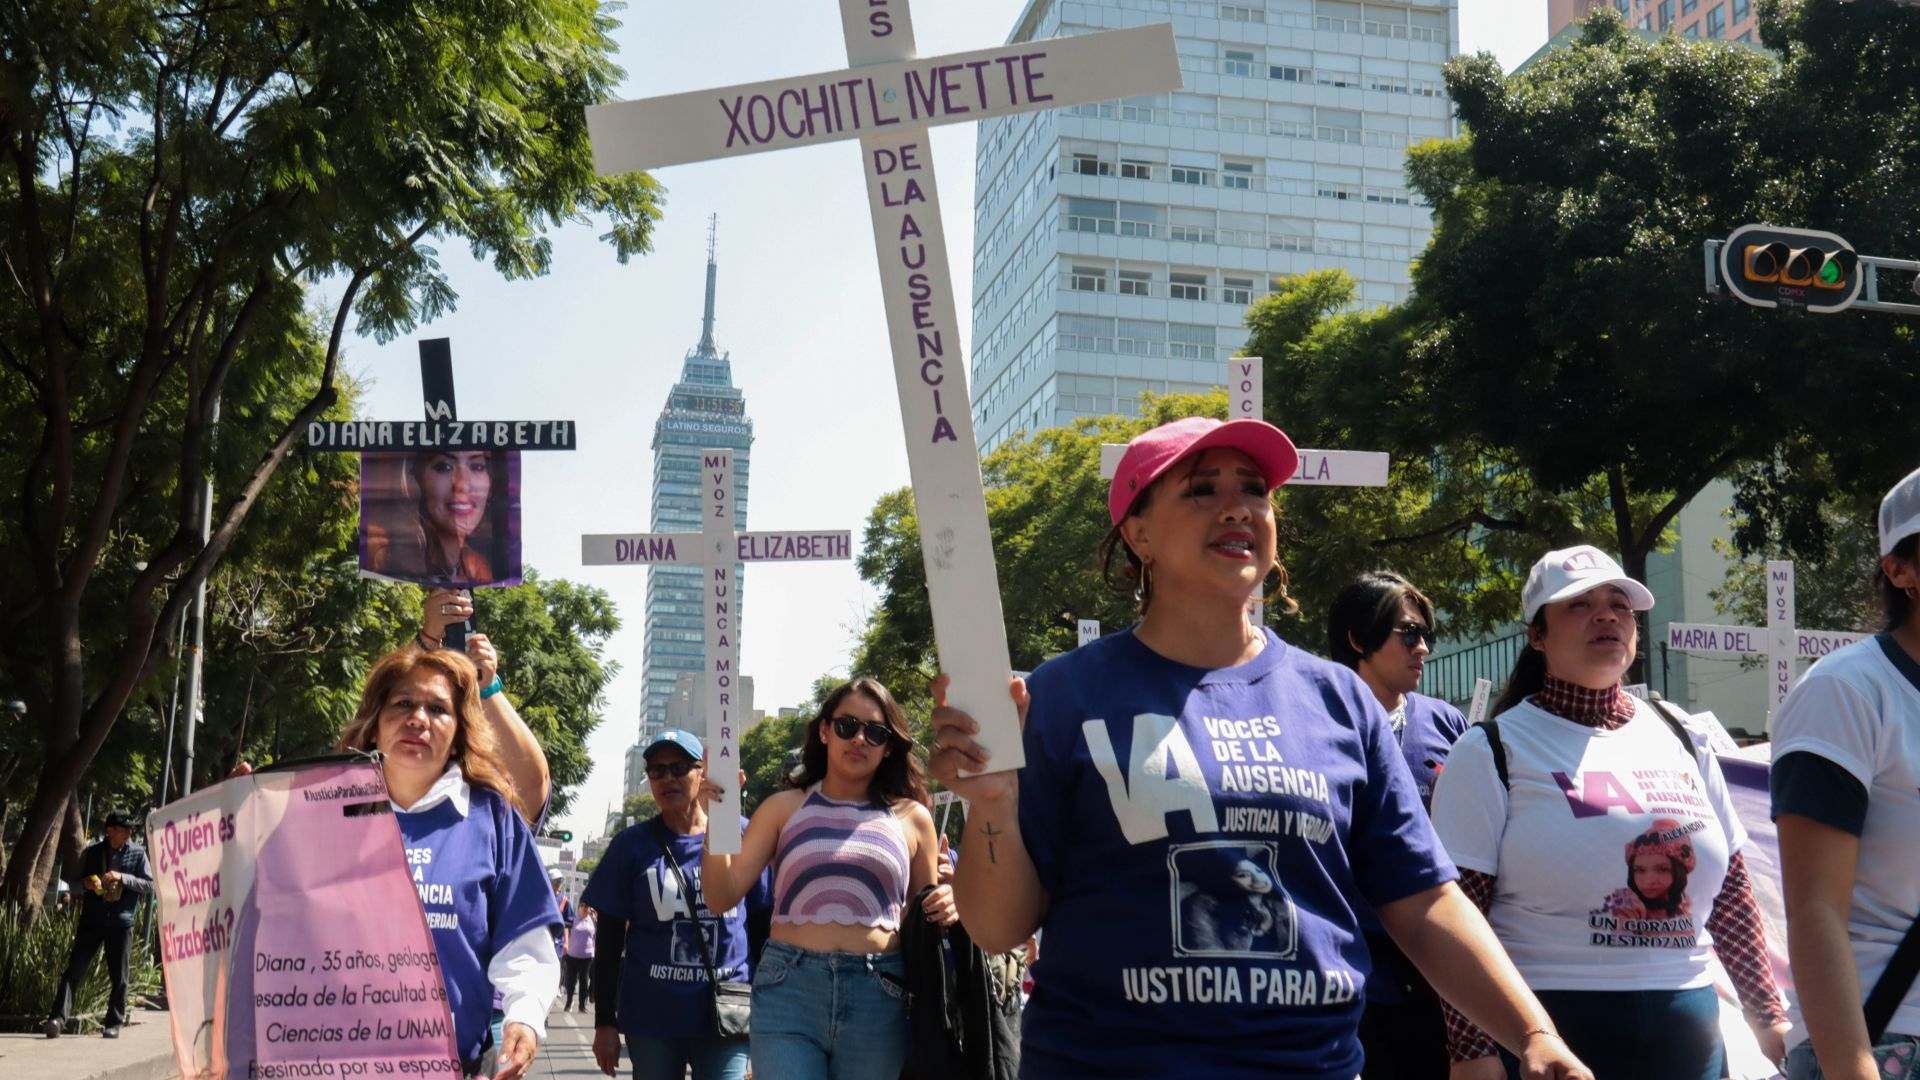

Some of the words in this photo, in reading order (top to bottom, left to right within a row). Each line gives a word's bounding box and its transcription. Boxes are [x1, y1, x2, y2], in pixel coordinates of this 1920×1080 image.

[718, 77, 900, 150] XOCHITL
[904, 52, 1054, 121] IVETTE
[873, 144, 921, 175] DE
[880, 178, 926, 207] LA
[899, 214, 958, 443] AUSENCIA
[1241, 363, 1252, 419] VOC
[425, 400, 453, 421] VA
[308, 421, 393, 448] DIANA
[402, 420, 569, 447] ELIZABETH
[667, 421, 700, 431] LATINO
[702, 423, 747, 435] SEGUROS
[704, 456, 727, 468] MI
[713, 475, 725, 518] VOZ
[615, 537, 677, 563] DIANA
[737, 533, 850, 561] ELIZABETH
[1772, 571, 1788, 582] MI
[714, 568, 730, 648] NUNCA
[1776, 586, 1786, 620] VOZ
[1671, 629, 1718, 650] MARIA
[1724, 632, 1758, 652] DEL
[1798, 635, 1857, 656] ROSA
[1777, 660, 1788, 704] NUN
[716, 659, 731, 758] MORIRA
[1204, 715, 1281, 739] VOCES
[1212, 739, 1244, 763] DE
[1248, 740, 1283, 763] LA
[1081, 713, 1220, 845] VA
[1220, 765, 1330, 803] AUSENCIA
[1551, 771, 1645, 819] VA
[1222, 806, 1279, 834] JUSTICIA
[1283, 811, 1293, 836] Y
[1662, 820, 1707, 843] ALEXANDRA
[160, 811, 215, 874] ¿Quién
[218, 813, 235, 842] es
[405, 847, 432, 865] CES
[174, 868, 221, 908] Diana
[162, 906, 235, 963] Elizabeth?
[1590, 916, 1618, 931] UN
[1591, 932, 1697, 949] DESTROZADO
[256, 952, 305, 973] Diana
[322, 950, 342, 971] 35
[345, 950, 385, 971] años,
[388, 950, 439, 974] geóloga
[650, 963, 694, 982] JUSTICIA
[256, 984, 308, 1007] esada
[313, 985, 336, 1006] de
[341, 984, 357, 1005] la
[362, 981, 427, 1005] Facultad
[430, 982, 447, 999] de
[1122, 966, 1242, 1005] JUSTICIA
[1250, 967, 1317, 1006] PARA
[266, 1022, 344, 1043] Ciencias
[349, 1020, 371, 1042] de
[375, 1019, 391, 1040] la
[397, 1018, 450, 1040] UNAM.
[340, 1061, 368, 1080] por
[375, 1060, 394, 1074] su
[399, 1058, 462, 1079] esposo
